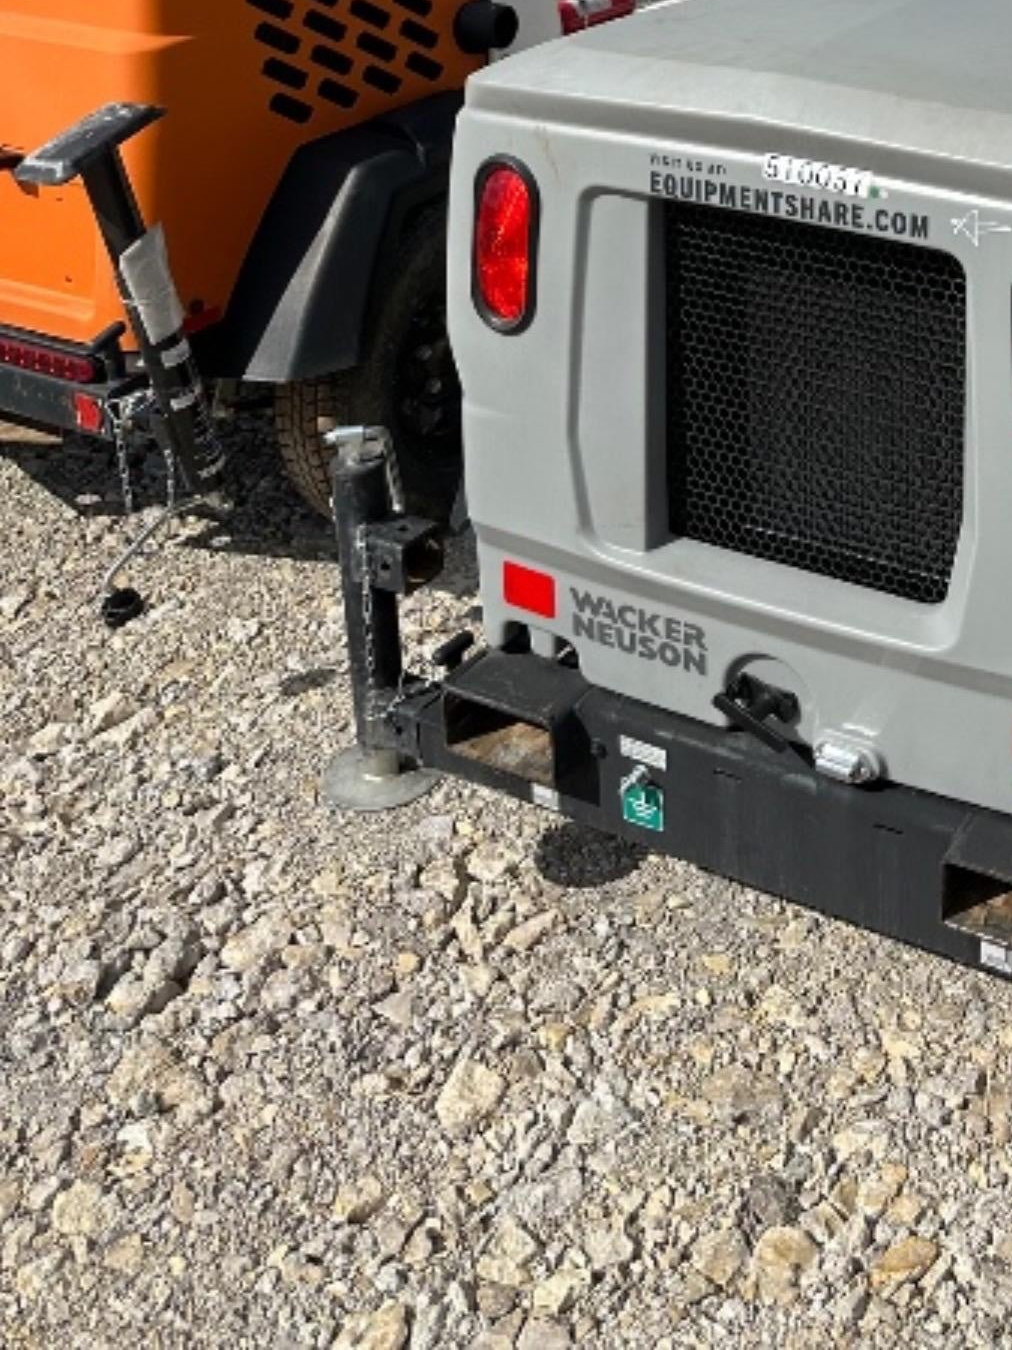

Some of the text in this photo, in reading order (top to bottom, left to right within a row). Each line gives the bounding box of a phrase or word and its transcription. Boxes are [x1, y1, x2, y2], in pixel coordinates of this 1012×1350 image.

[650, 172, 929, 238] EQUIPMENTSHARE.COM
[569, 586, 708, 652] WACKER
[571, 611, 708, 676] NEUSON
